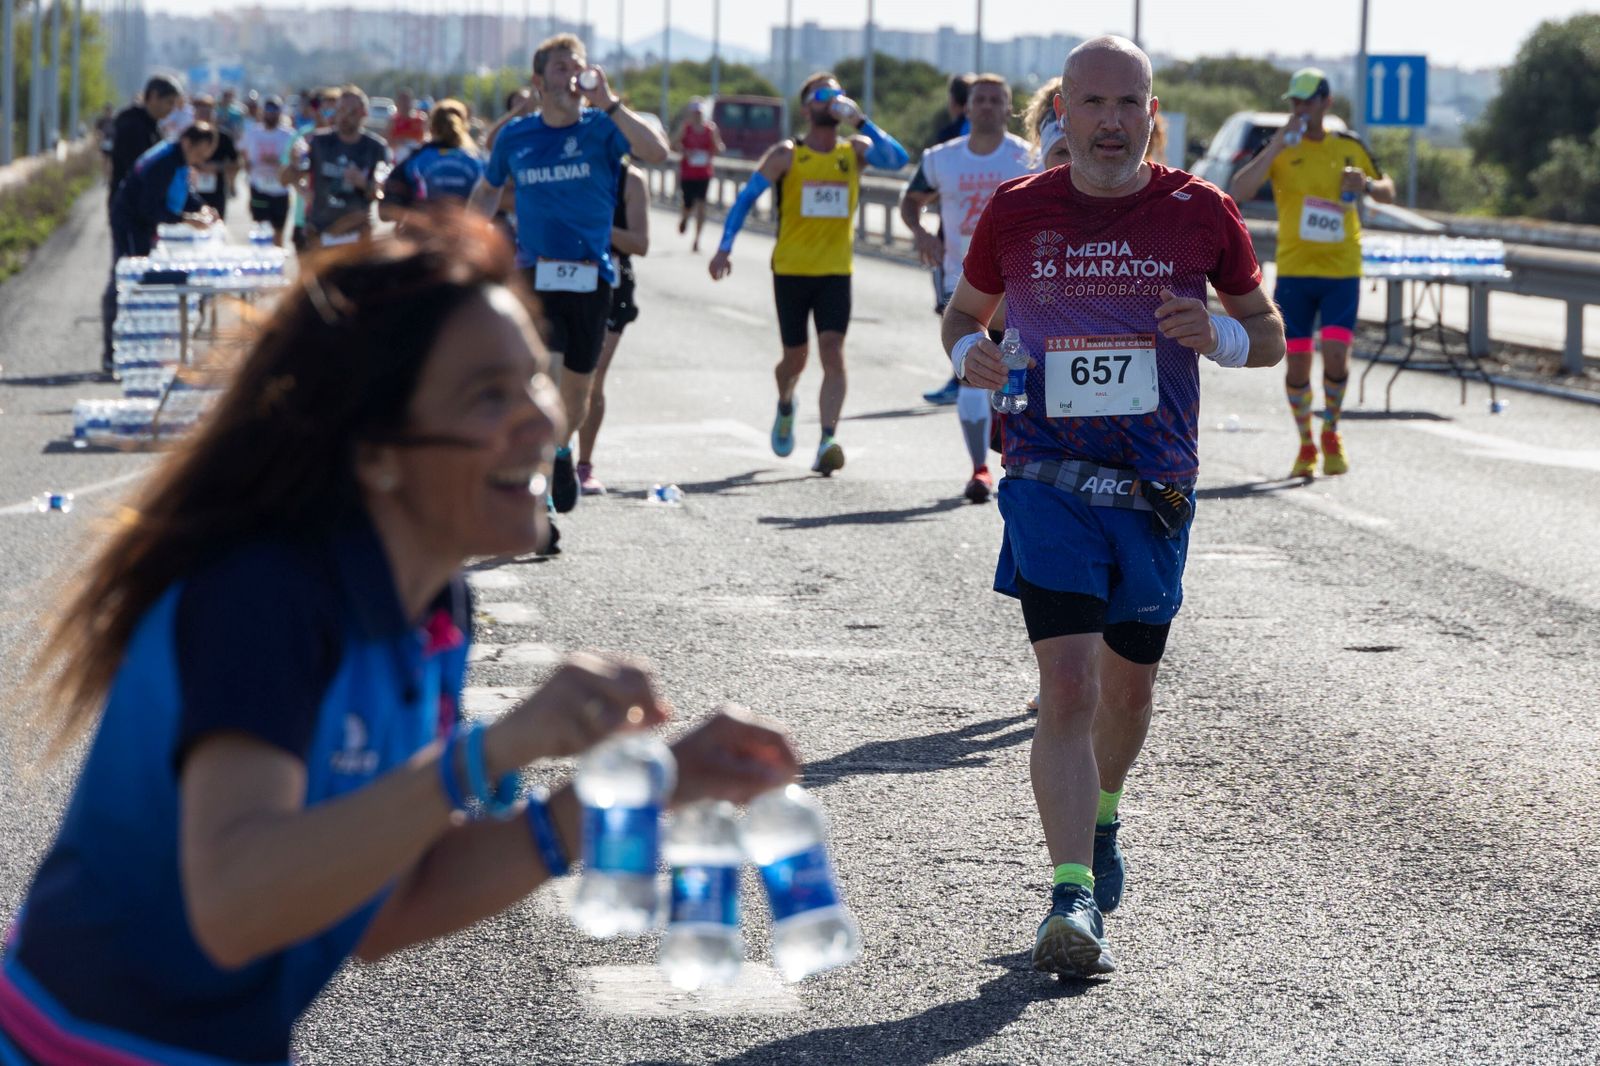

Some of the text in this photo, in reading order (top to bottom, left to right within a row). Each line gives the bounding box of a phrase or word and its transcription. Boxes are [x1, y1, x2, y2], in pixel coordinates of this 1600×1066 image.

[527, 163, 591, 184] BULEVAR
[815, 190, 840, 203] 561
[1307, 213, 1340, 232] 800
[1066, 240, 1133, 258] MEDIA
[556, 265, 578, 278] 57
[1031, 255, 1174, 279] 36 MARATÓN
[1071, 355, 1132, 386] 657
